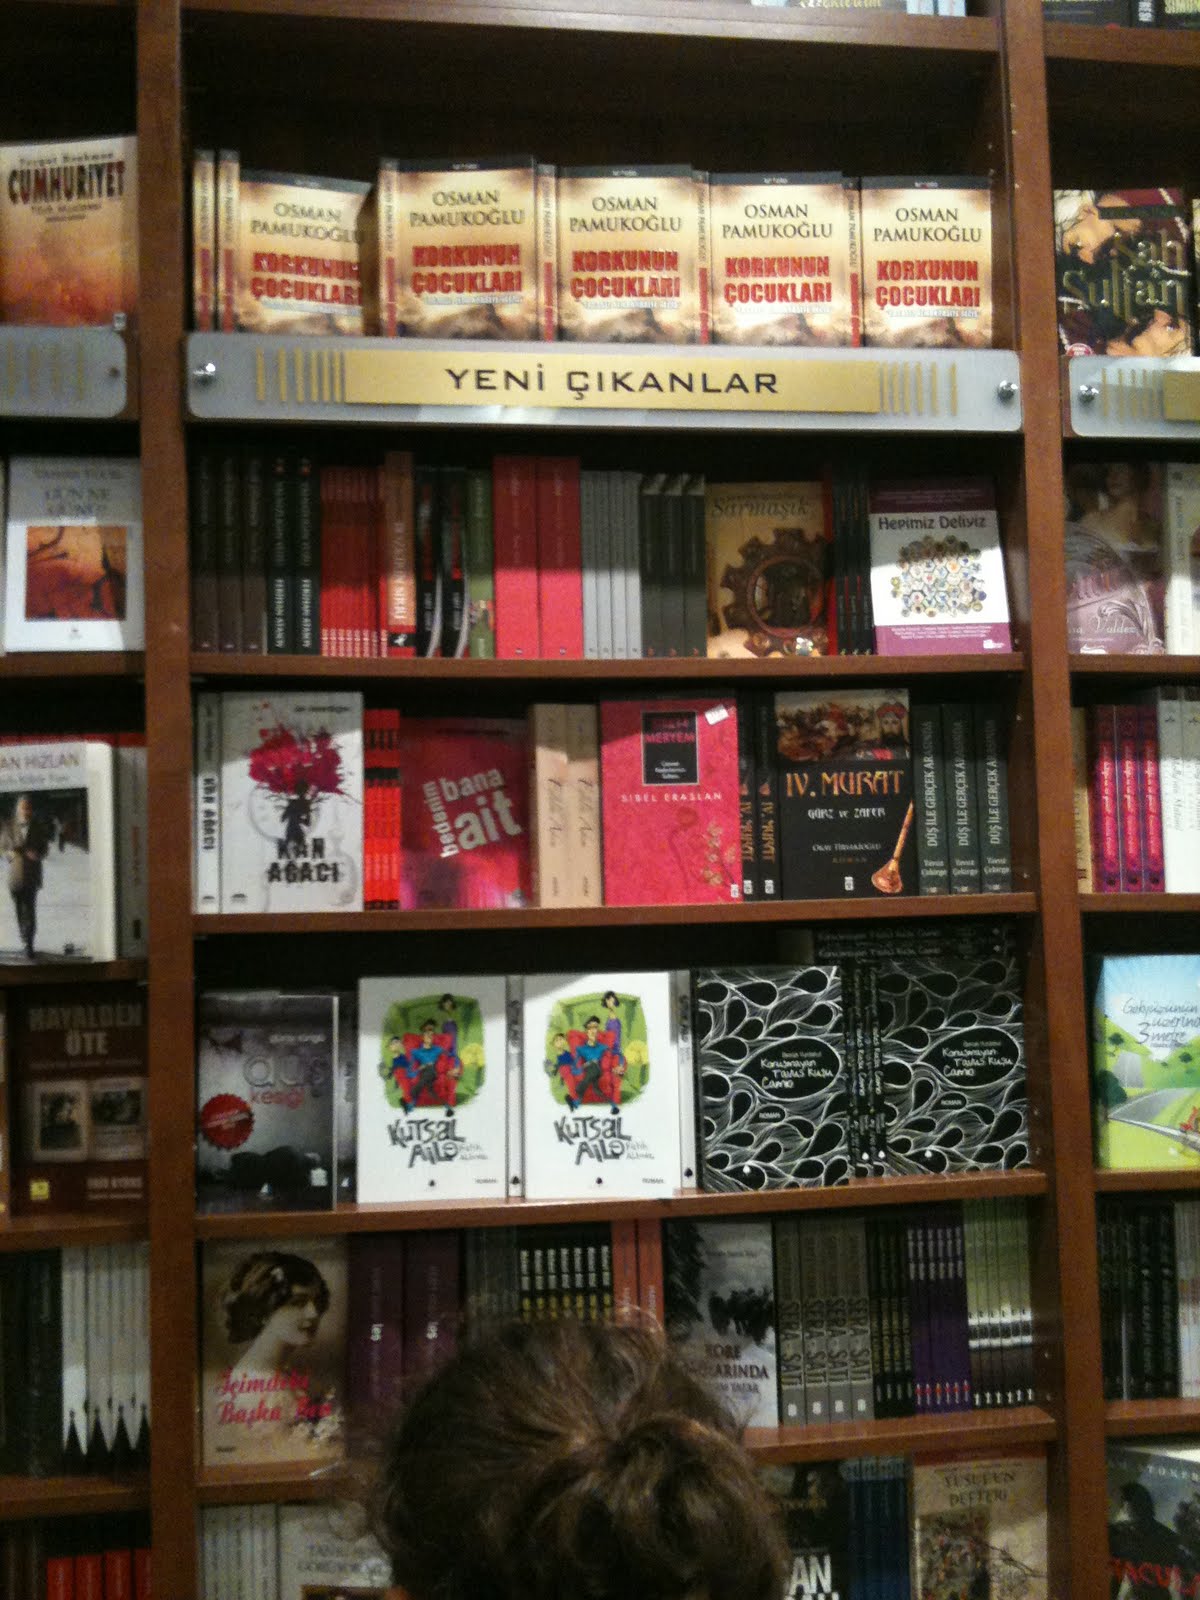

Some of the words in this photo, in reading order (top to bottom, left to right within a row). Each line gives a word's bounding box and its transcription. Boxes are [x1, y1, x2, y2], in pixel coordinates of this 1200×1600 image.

[430, 190, 501, 208] OSMAN
[591, 196, 657, 212] OSMAN
[744, 203, 809, 219] OSMAN
[272, 200, 342, 224] OSMAN
[410, 208, 526, 229] PAMUKOĞLU
[569, 215, 682, 233] PAMUKOĞLU
[895, 207, 958, 223] OSMAN
[722, 222, 833, 240] PAMUKOĞLU
[873, 226, 982, 243] PAMUKOĞLU
[411, 244, 520, 268] KORKUNUN
[572, 250, 679, 272] KORKUNUN
[724, 256, 830, 278] KORKUNUN
[876, 260, 978, 282] KORKUNUN
[250, 277, 361, 306] ÇOCUKLARI
[410, 271, 523, 297] ÇOCUKLARI
[570, 277, 680, 301] ÇOCUKLARI
[723, 282, 832, 307] ÇOCUKLARI
[875, 286, 981, 310] ÇOCUKLARI
[444, 363, 545, 392] YENİ
[566, 370, 780, 401] ÇIKANLAR
[878, 516, 935, 532] Hepimiz
[439, 767, 505, 803] bana
[786, 771, 816, 797] IV.
[821, 770, 905, 796] MURAT
[923, 771, 938, 809] GERÇEK
[955, 771, 969, 809] GERÇEK
[986, 769, 1000, 807] GERÇEK
[453, 788, 522, 851] ait
[277, 837, 325, 859] KAN
[1136, 1021, 1150, 1045] 3
